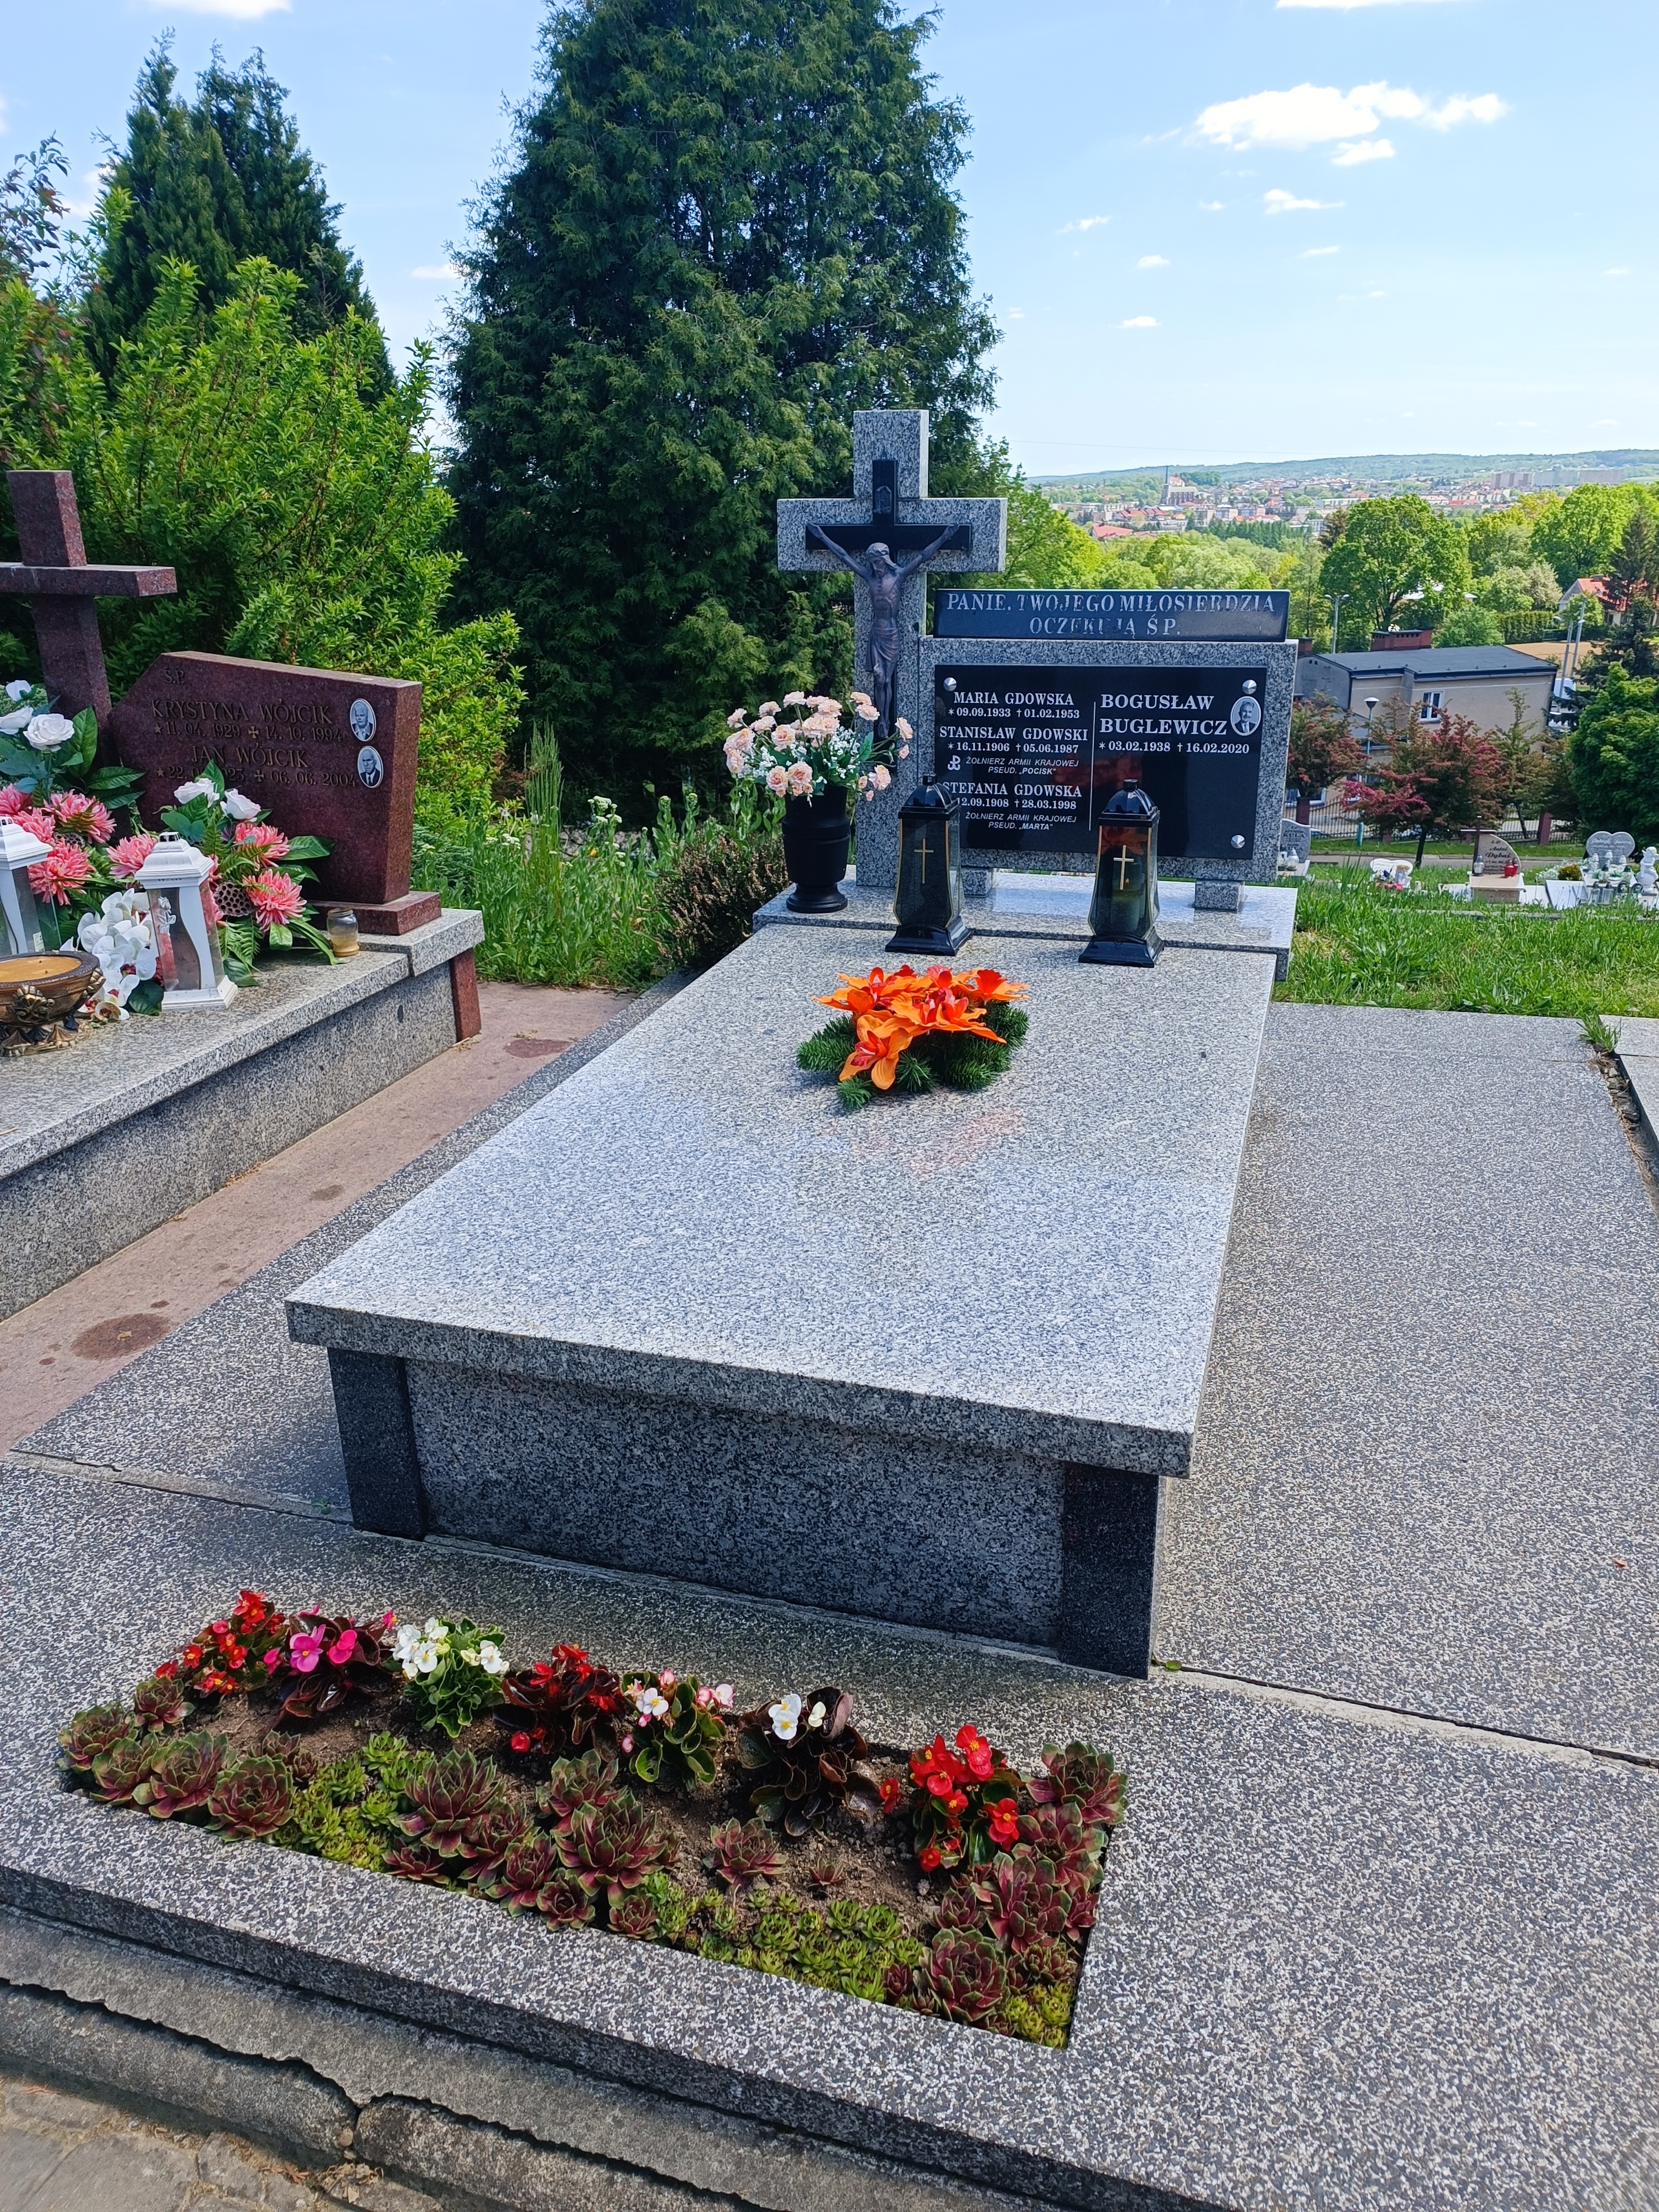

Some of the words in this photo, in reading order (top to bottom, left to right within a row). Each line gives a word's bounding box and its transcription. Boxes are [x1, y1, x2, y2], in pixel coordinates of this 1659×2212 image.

[1016, 594, 1114, 612] TWOJEGO
[1119, 594, 1275, 612] MIŁOSIERDZIA
[1030, 617, 1136, 639] OCZEKUJĄ
[954, 692, 999, 704] MARIA
[1005, 692, 1074, 706] GDOWSKA
[1100, 694, 1214, 710] BOGUSŁAW
[152, 700, 249, 721] KRYSTYNA
[258, 698, 333, 724] WÓJCIK
[956, 707, 1011, 717] 09.09.1933
[1024, 708, 1080, 718] 01.02.1953
[184, 722, 206, 737] 04.
[211, 723, 241, 738] 1929
[265, 726, 282, 740] 14.
[288, 726, 305, 740] 10.
[311, 727, 342, 742] 1994
[940, 726, 1016, 739] STANISŁAW
[1022, 728, 1088, 741] GDOWSKI
[1099, 718, 1227, 735] BUGLEWICZ
[956, 742, 1010, 752] 16.11.1906
[1023, 744, 1079, 754] 05.06.1987
[1108, 740, 1171, 752] 03.02.1938
[1186, 743, 1250, 754] 16.02.2020
[192, 746, 225, 764] JAN
[236, 743, 309, 768] WÓJCIK
[966, 756, 1005, 765] ŻOŁNIERZ
[168, 765, 187, 780] 22.
[270, 770, 291, 784] 06.
[295, 771, 316, 785] 06.
[322, 772, 356, 787] 2004
[942, 782, 1008, 795] STEFANIA
[1014, 784, 1082, 797] GDOWSKA
[956, 797, 1009, 807] 12.09.1908
[1022, 799, 1077, 810] 28.03.1998
[965, 811, 1004, 820] ŻOŁNIERZ
[1033, 815, 1077, 823] KRAJOWEJ
